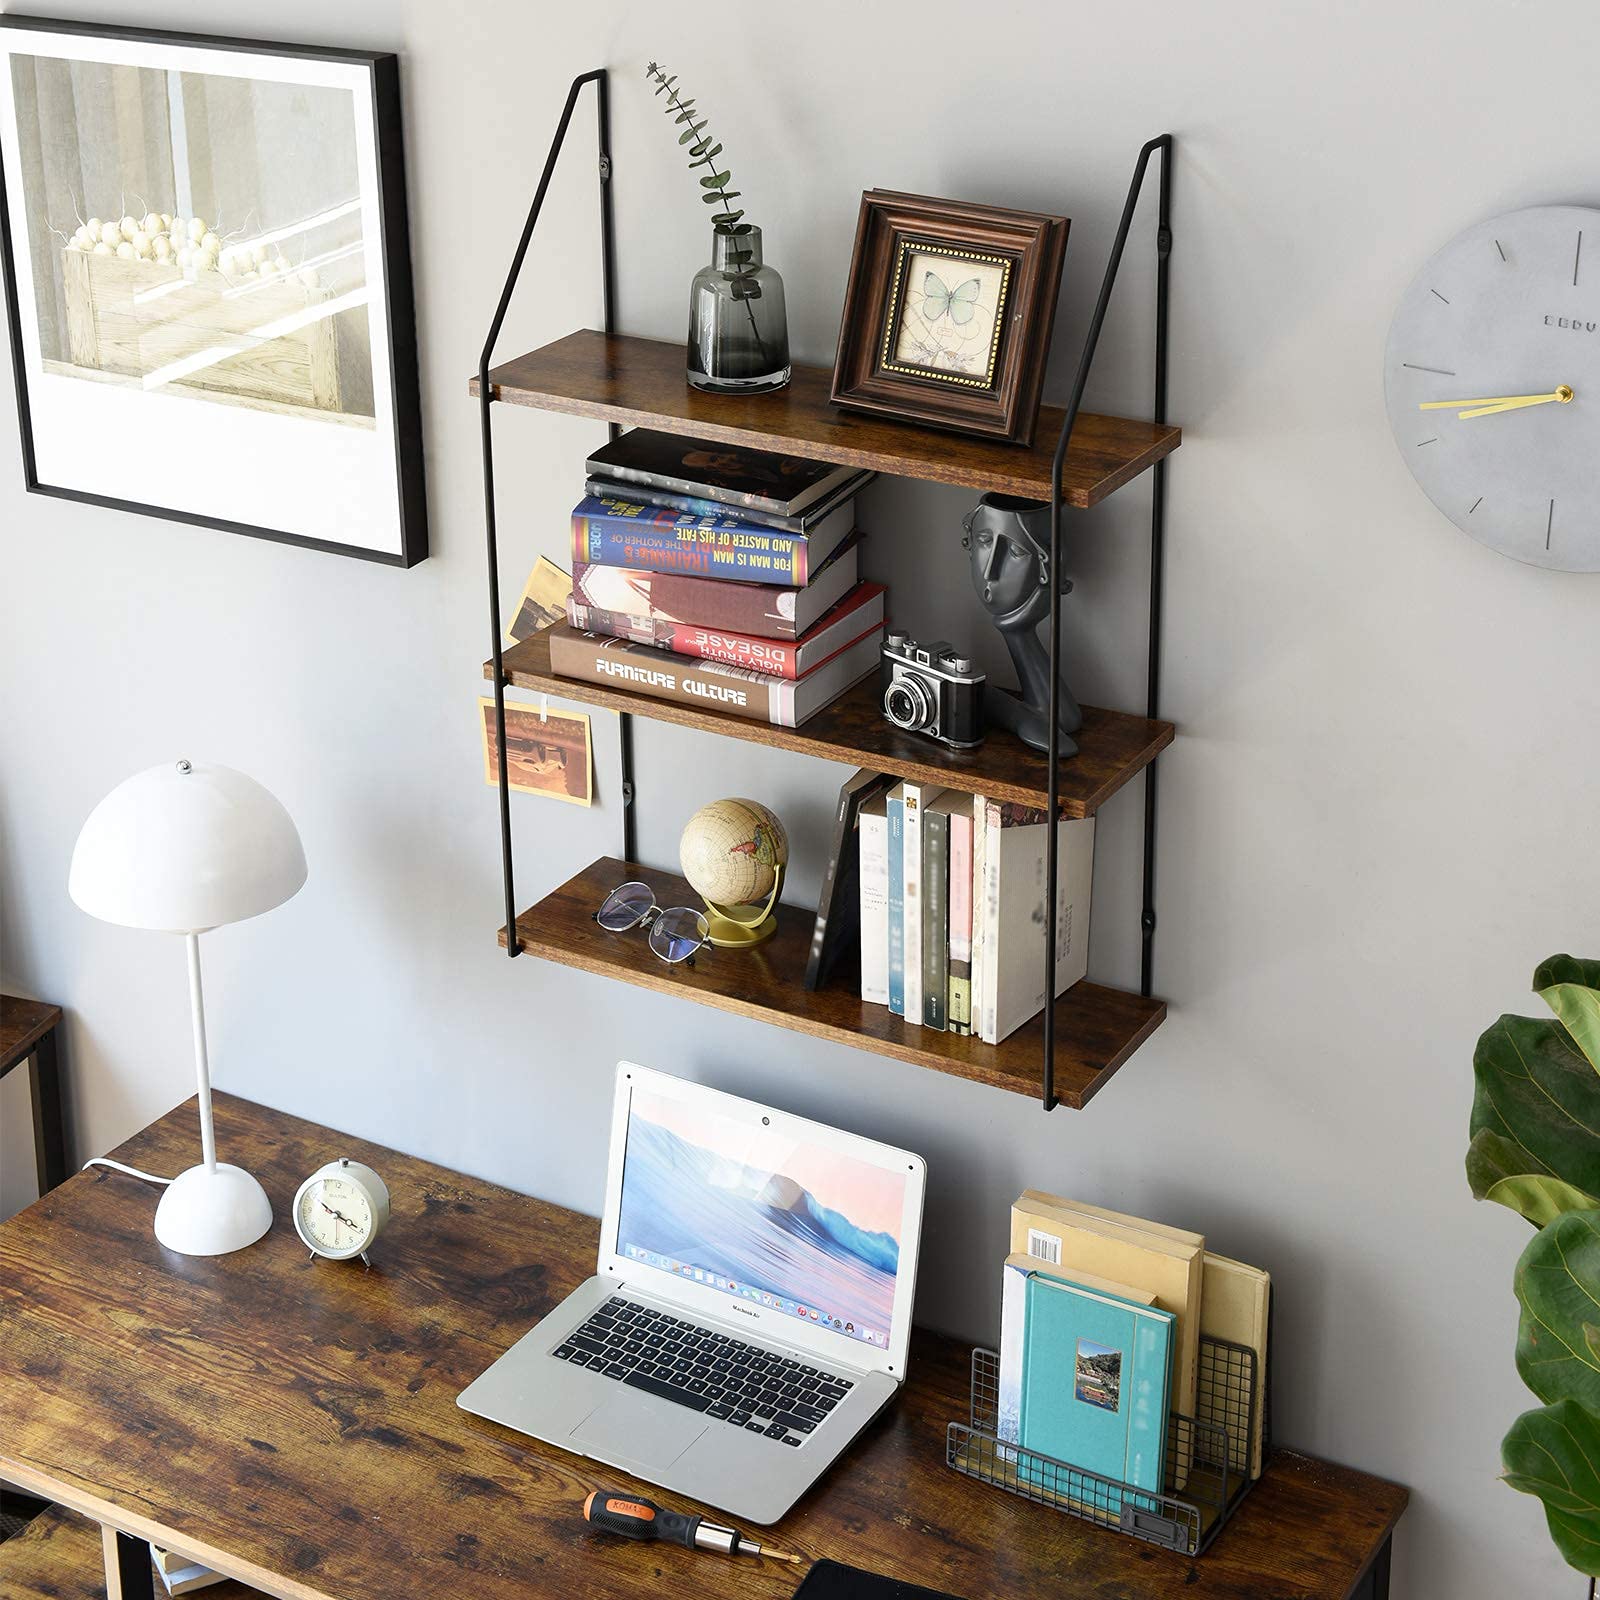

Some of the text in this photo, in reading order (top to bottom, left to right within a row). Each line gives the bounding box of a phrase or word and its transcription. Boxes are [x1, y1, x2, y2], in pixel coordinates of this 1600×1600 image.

[610, 534, 682, 550] THE MOTHER OF
[673, 527, 792, 553] AND MASTER OF HIS FATE.
[713, 550, 792, 571] FOR MAN IS MAN
[695, 631, 785, 662] DISEASE
[700, 645, 783, 672] UGLY TRUTH
[682, 679, 747, 706] CULTURE
